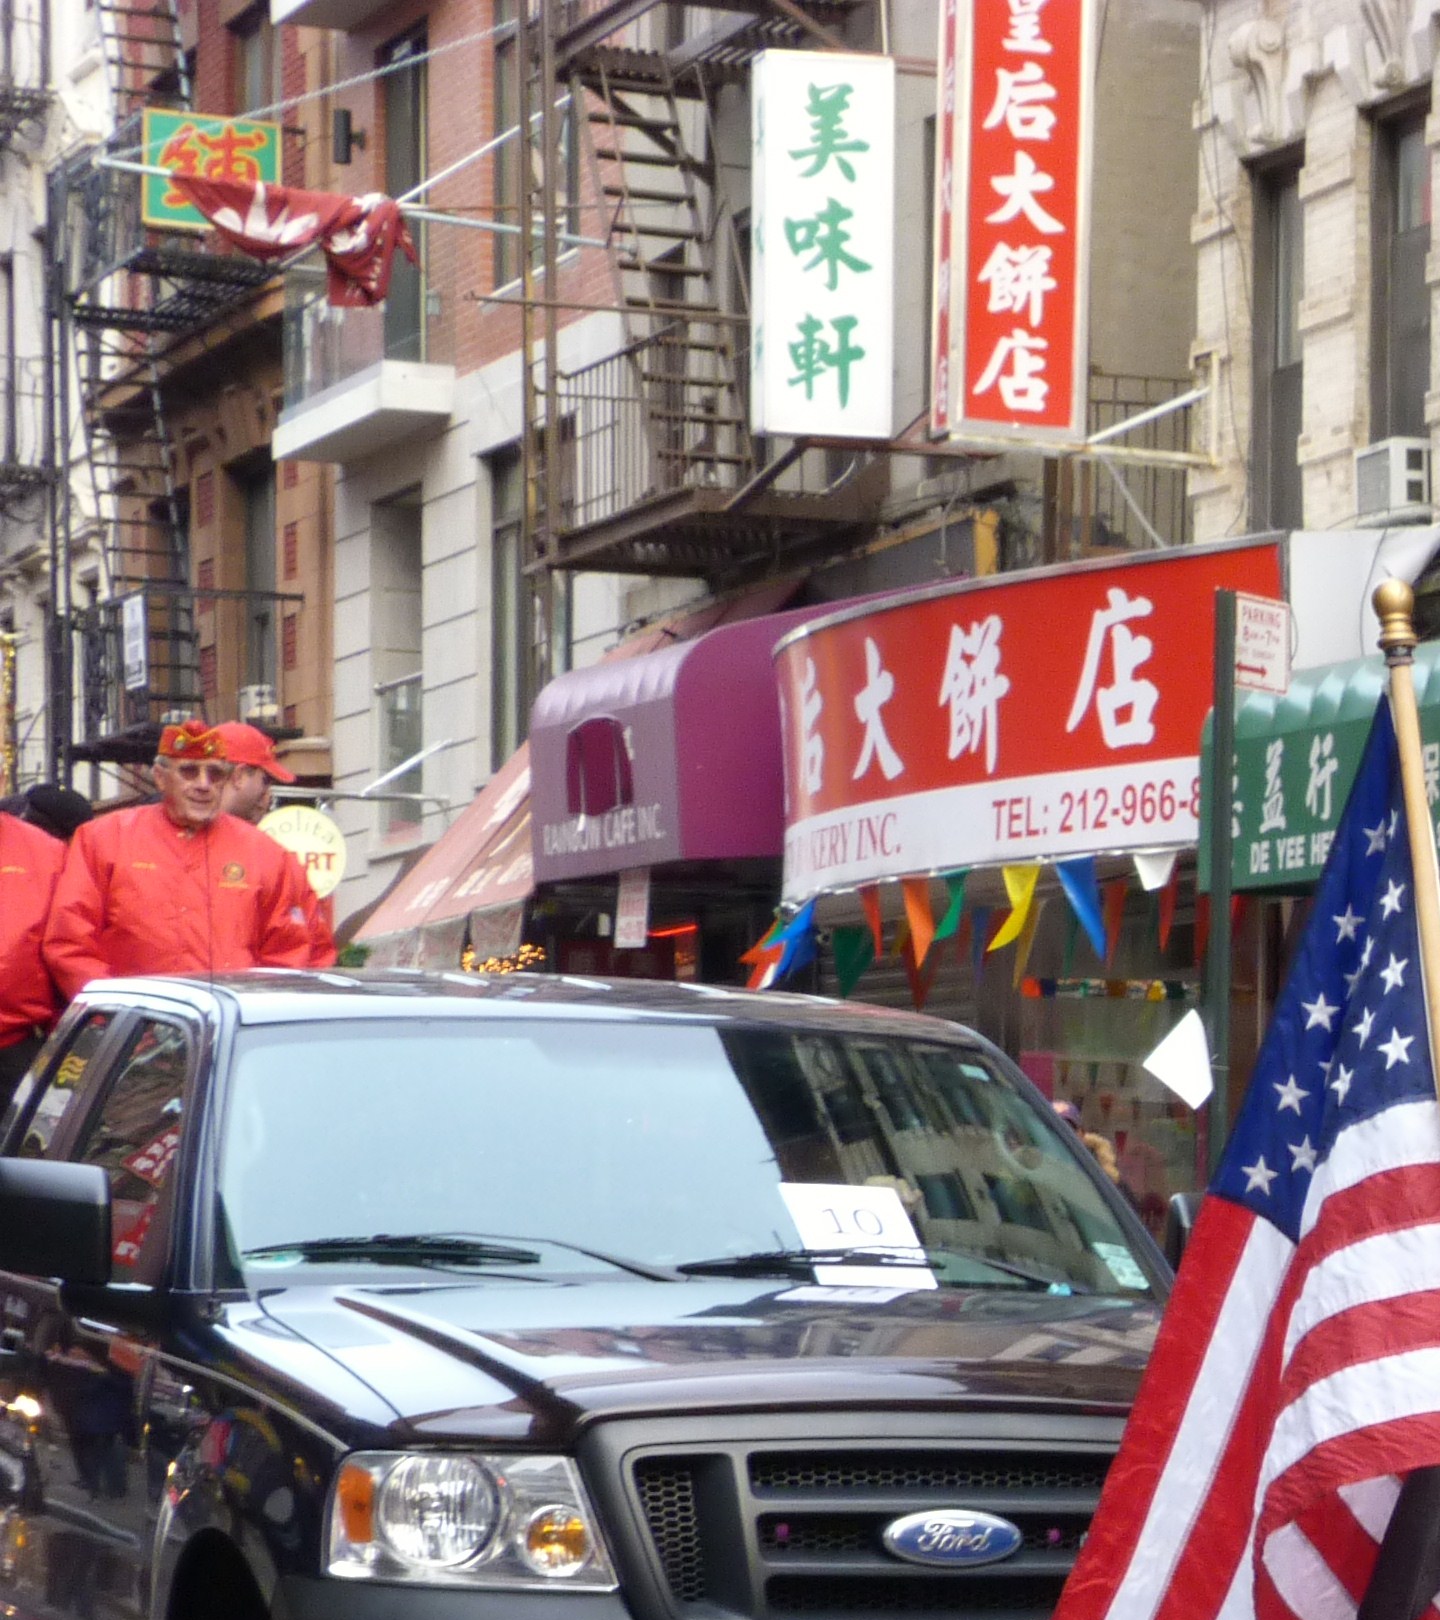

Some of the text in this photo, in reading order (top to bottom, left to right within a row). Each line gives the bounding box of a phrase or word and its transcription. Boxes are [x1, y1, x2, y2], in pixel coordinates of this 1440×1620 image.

[782, 80, 873, 411] 美味軒
[1242, 605, 1283, 630] PARKING
[780, 587, 1160, 797] 后大餅店
[603, 807, 636, 848] CAFE
[856, 811, 902, 861] INC.
[992, 793, 1050, 842] TEL:
[1250, 839, 1270, 875] DE
[1276, 834, 1306, 870] YEE
[820, 1204, 887, 1239] 10
[915, 1518, 995, 1554] Ford
